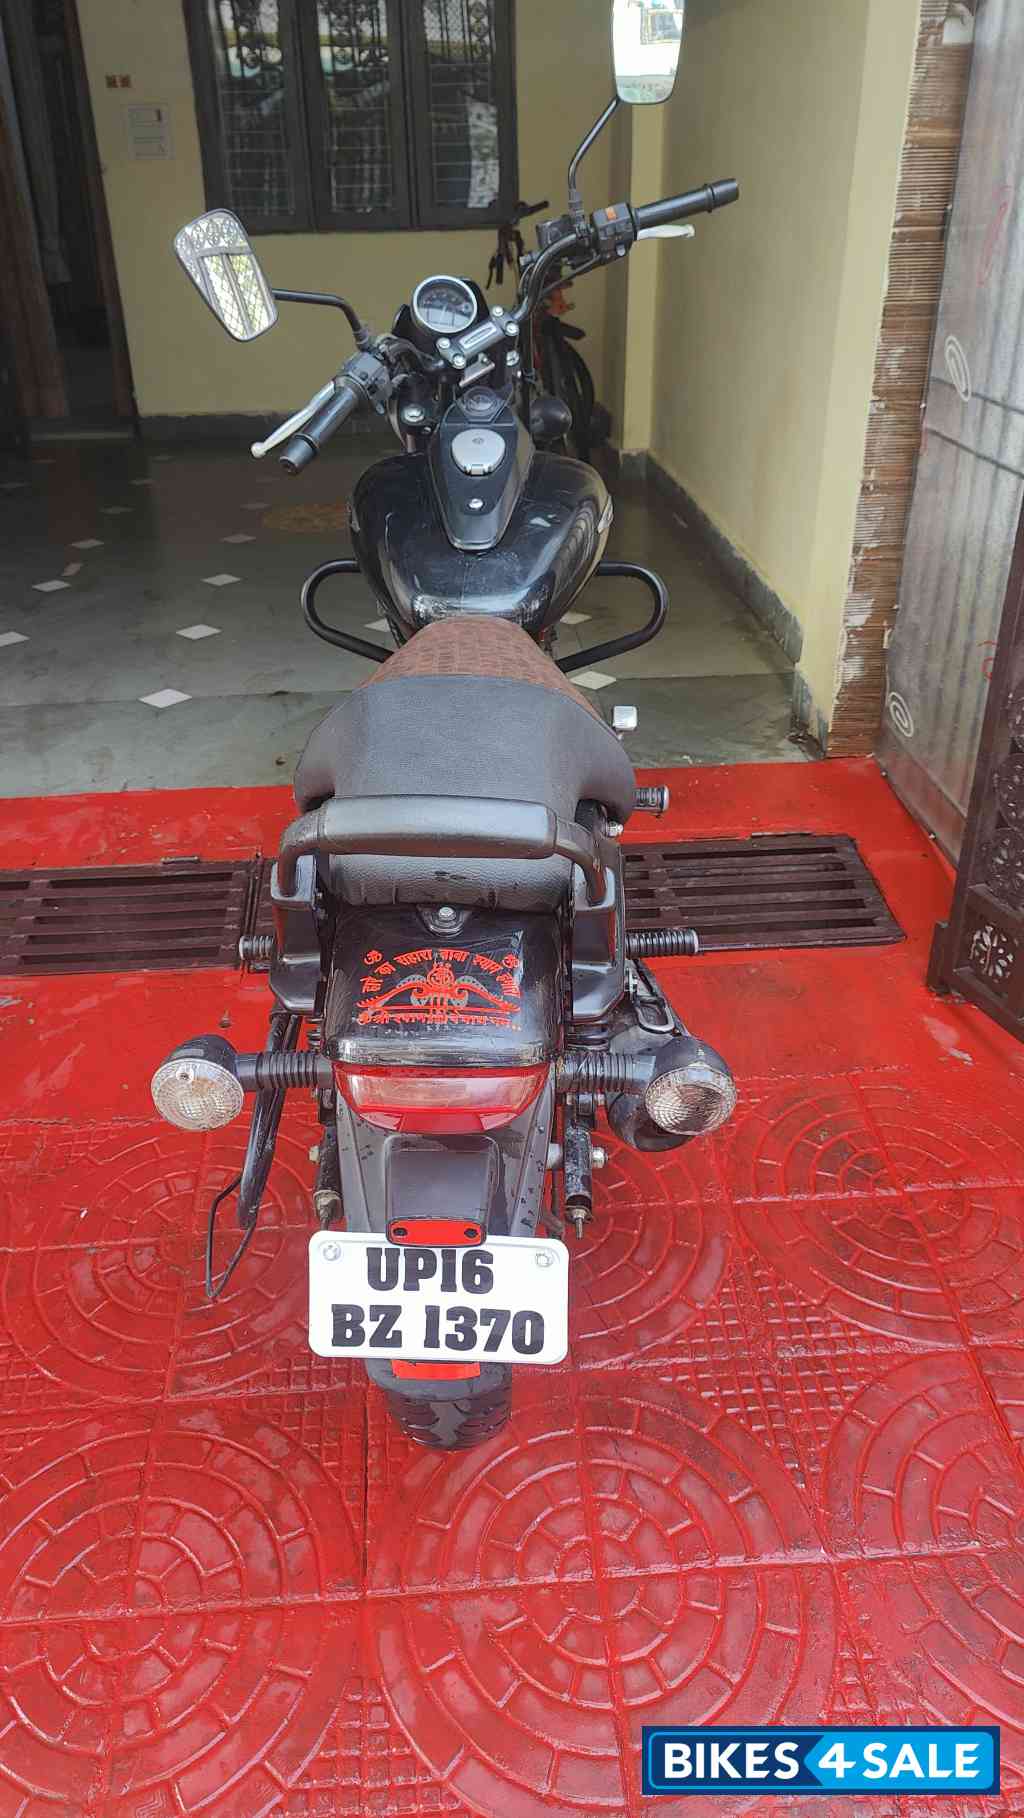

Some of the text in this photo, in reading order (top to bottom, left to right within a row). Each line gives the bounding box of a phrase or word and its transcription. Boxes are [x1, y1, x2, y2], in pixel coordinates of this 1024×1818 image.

[366, 1247, 494, 1294] UP16
[331, 1304, 545, 1355] BZ 1370
